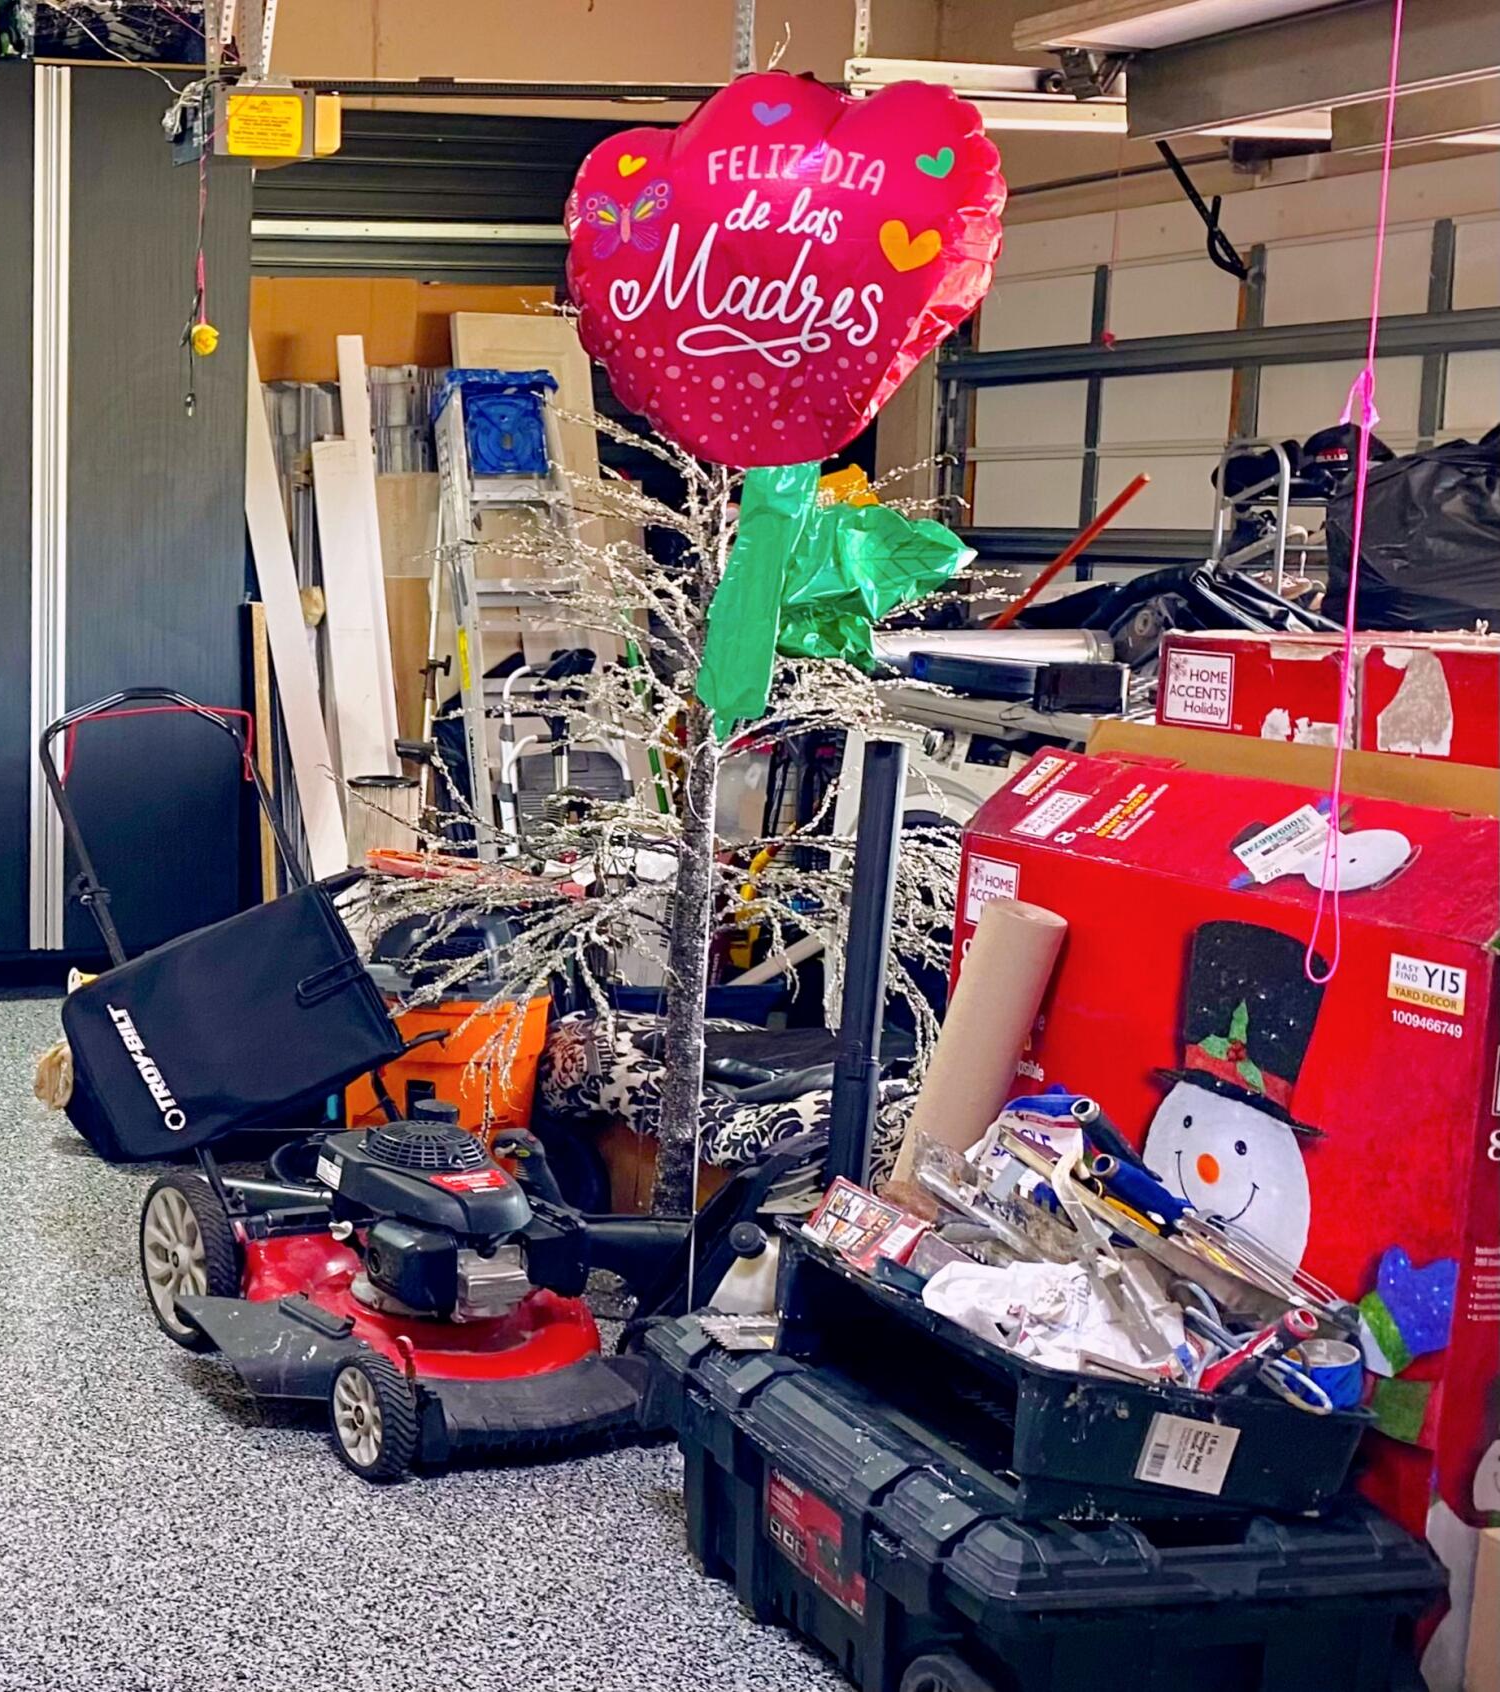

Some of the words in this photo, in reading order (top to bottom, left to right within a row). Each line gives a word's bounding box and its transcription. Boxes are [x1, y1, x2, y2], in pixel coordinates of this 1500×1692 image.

[707, 143, 808, 185] FELIZ
[724, 190, 771, 231] de
[777, 186, 844, 245] las
[609, 222, 884, 355] Madres
[1189, 668, 1228, 684] HOME
[1169, 684, 1227, 702] ACCENTS
[1183, 700, 1226, 720] Holiday
[1053, 830, 1077, 844] 8
[985, 874, 1014, 893] HOME
[1395, 970, 1418, 983] FIND
[1396, 961, 1419, 973] EASY
[1423, 965, 1460, 994] Y15
[1394, 986, 1421, 1001] YARD
[1422, 993, 1458, 1010] DECOR
[1392, 1008, 1463, 1039] 1009466749
[107, 1004, 177, 1112] TROY-BILT
